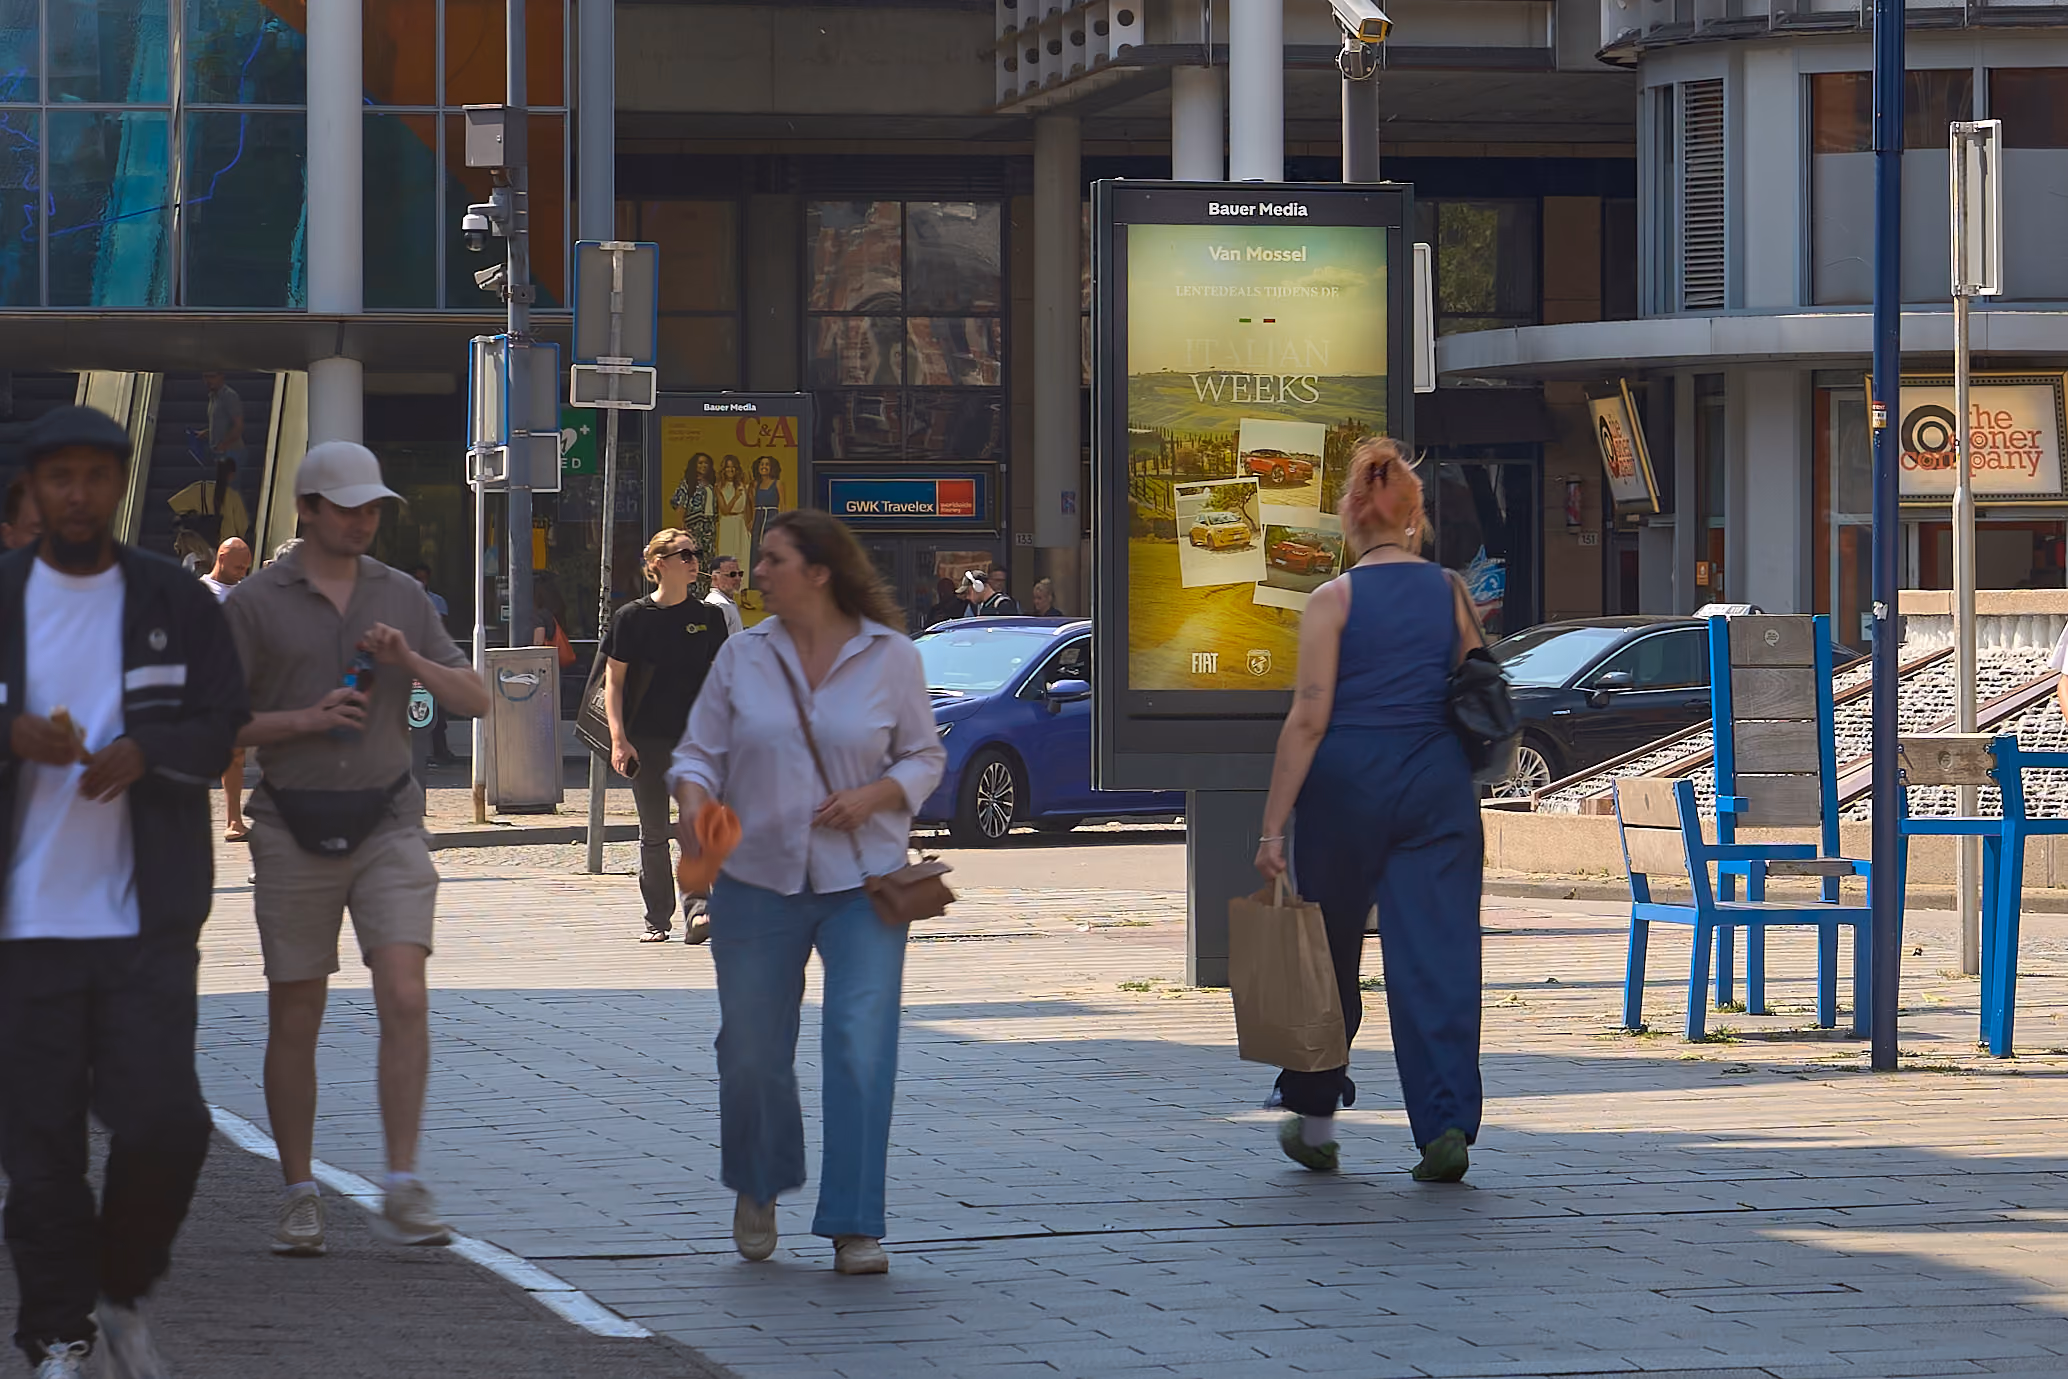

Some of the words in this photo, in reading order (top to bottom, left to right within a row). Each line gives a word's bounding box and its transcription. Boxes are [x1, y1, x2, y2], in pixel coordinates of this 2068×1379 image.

[1208, 202, 1256, 216] Bauer
[1259, 202, 1308, 216] Media
[1208, 246, 1241, 261] Van
[1246, 246, 1307, 262] Mossel
[1176, 286, 1262, 297] LENTEDEALS
[1264, 286, 1319, 298] TIJDENS
[1321, 287, 1339, 297] DE
[1185, 338, 1330, 368] ITALIAN
[1188, 374, 1320, 404] WEEKS
[703, 403, 729, 411] Bauer
[730, 403, 757, 411] Media
[1968, 404, 2013, 430] he
[735, 416, 798, 448] C&A
[561, 458, 581, 469] ED
[846, 501, 880, 513] GWK
[881, 501, 934, 513] Travelex
[1191, 652, 1219, 674] FIAT
